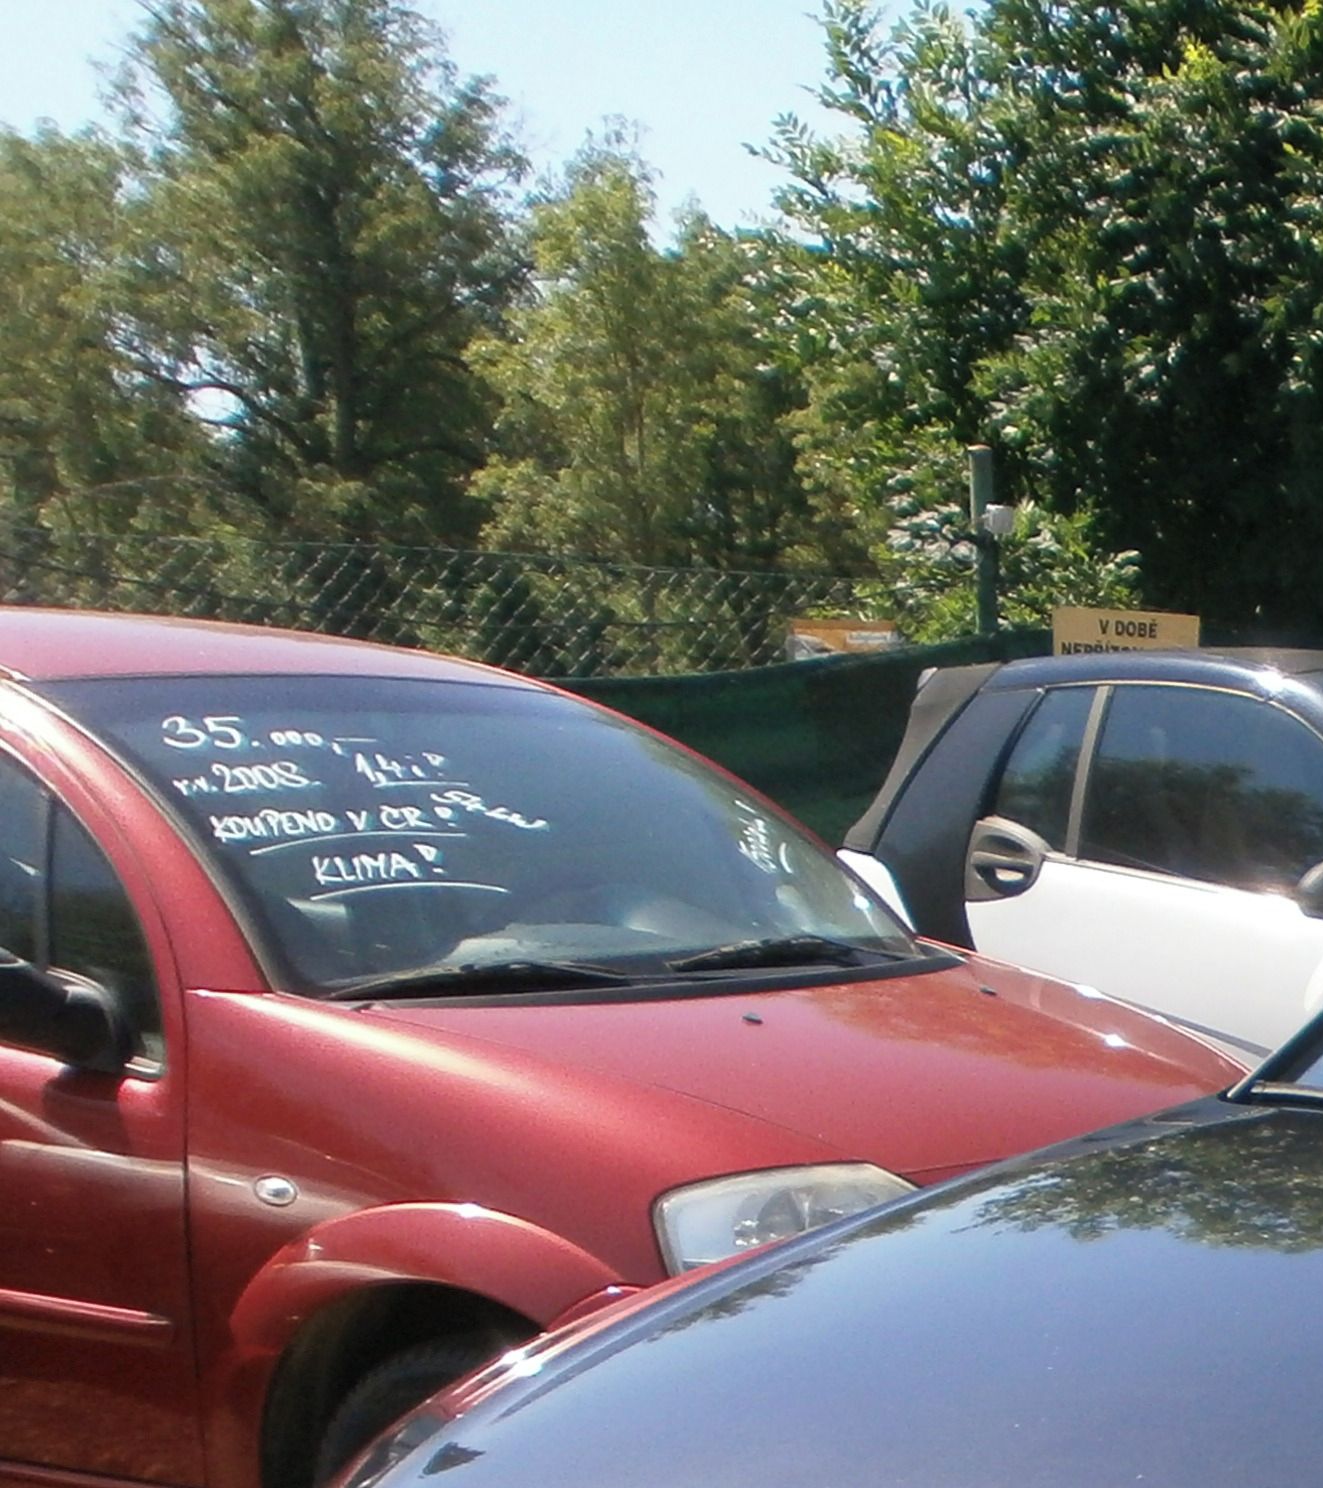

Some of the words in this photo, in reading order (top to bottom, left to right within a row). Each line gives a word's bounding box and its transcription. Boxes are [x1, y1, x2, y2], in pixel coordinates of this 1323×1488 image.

[1098, 618, 1110, 636] V
[1114, 618, 1159, 639] DOBĚ
[210, 807, 335, 842] KOUPENO
